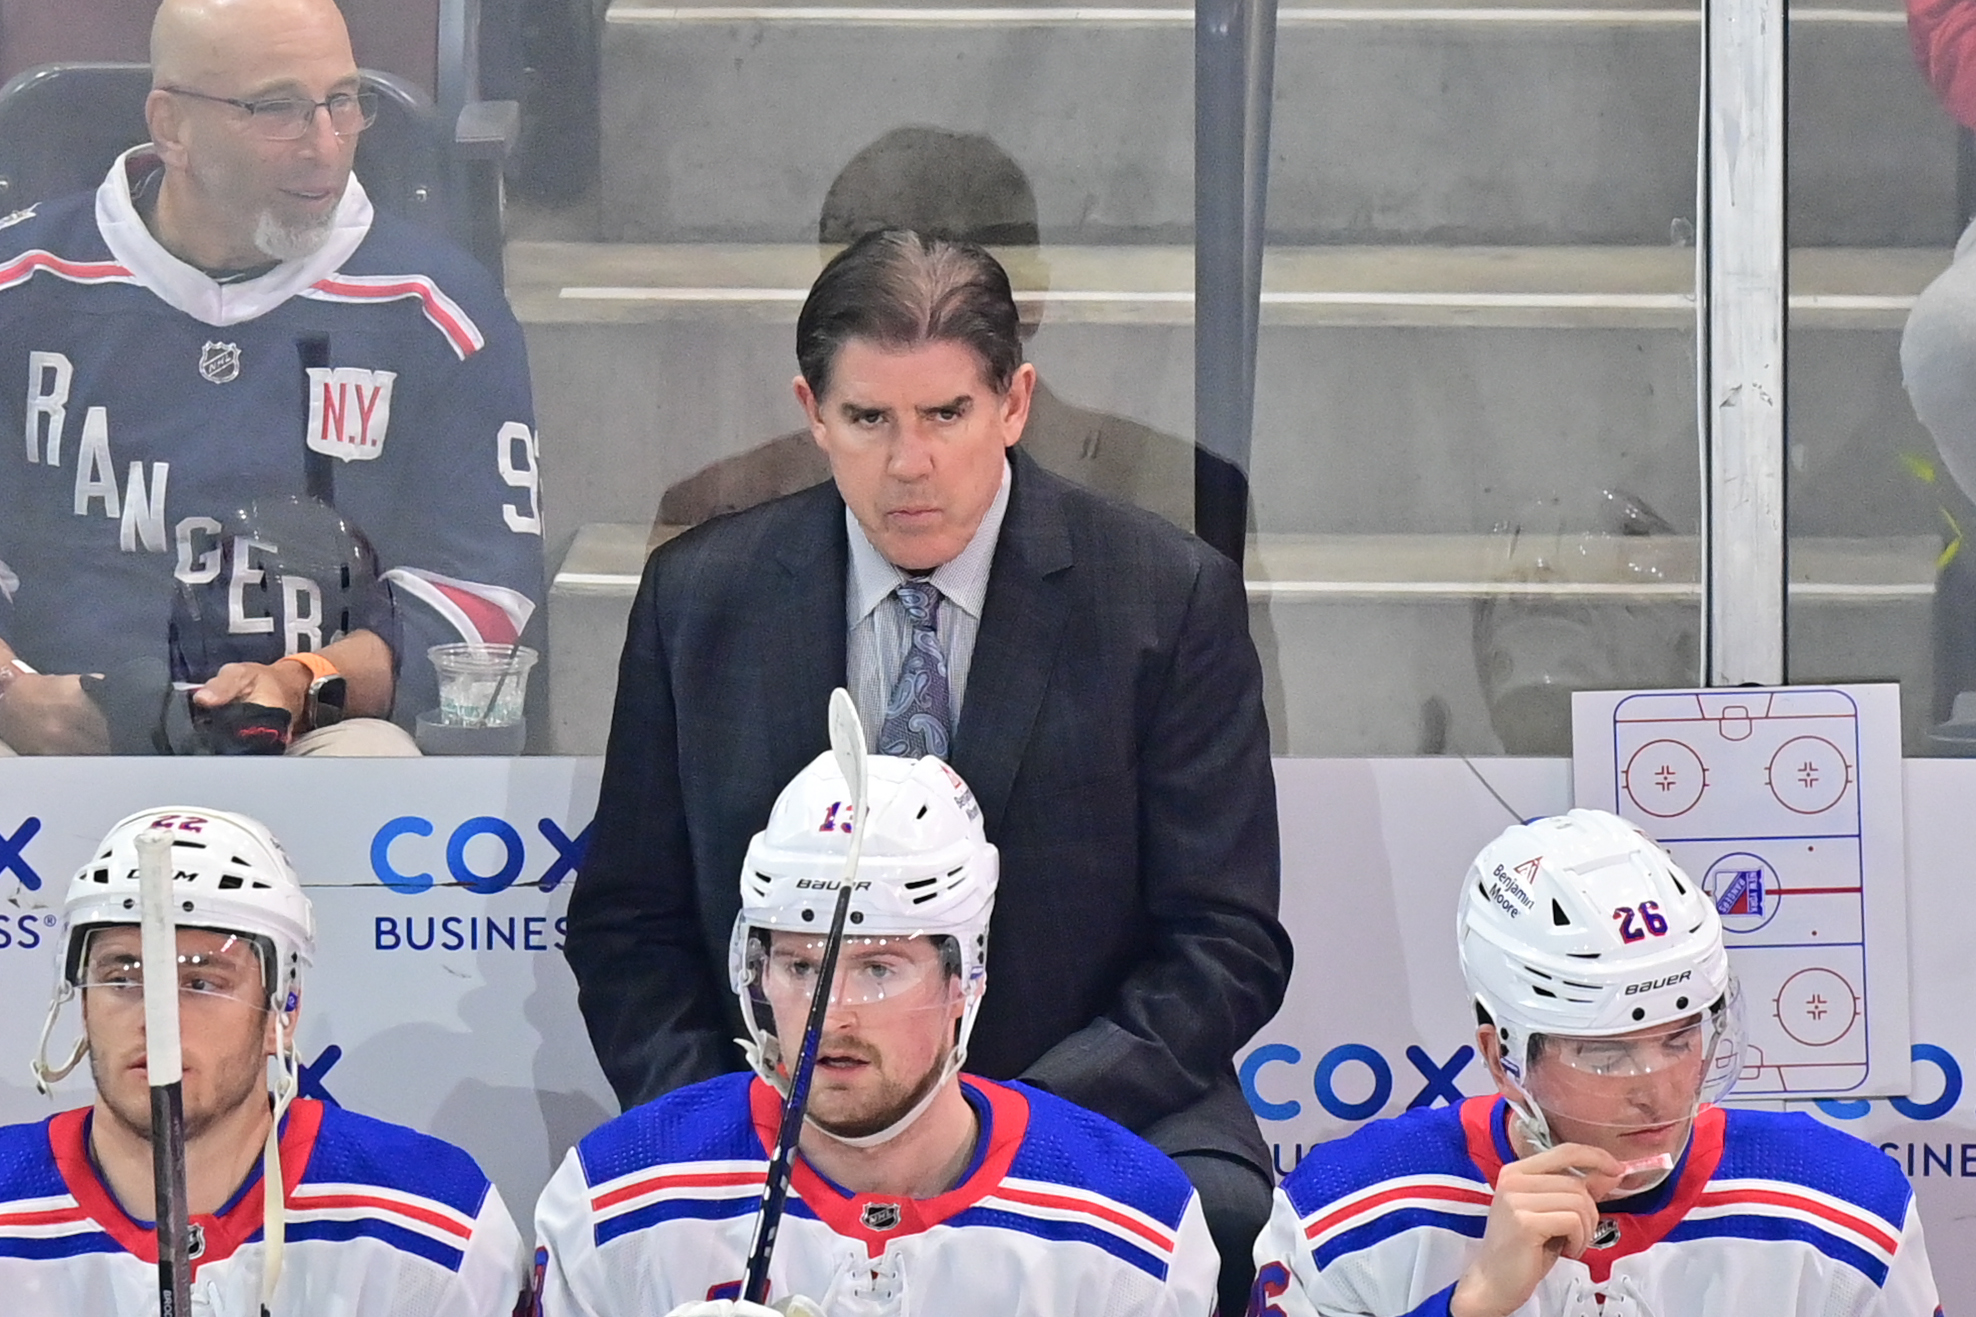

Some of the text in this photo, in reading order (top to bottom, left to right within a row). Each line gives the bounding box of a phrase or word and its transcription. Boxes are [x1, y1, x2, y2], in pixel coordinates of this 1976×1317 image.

[321, 382, 381, 447] N.Y.
[26, 351, 346, 656] RANGER
[497, 421, 545, 540] 9
[370, 816, 598, 895] COX
[796, 878, 872, 891] BAUR
[1489, 882, 1519, 919] Moore
[1493, 863, 1535, 910] Benjamin
[1718, 877, 1746, 913] RANGERS
[1612, 900, 1668, 944] 26
[1624, 970, 1692, 996] BAUER
[1238, 1043, 1475, 1121] COX
